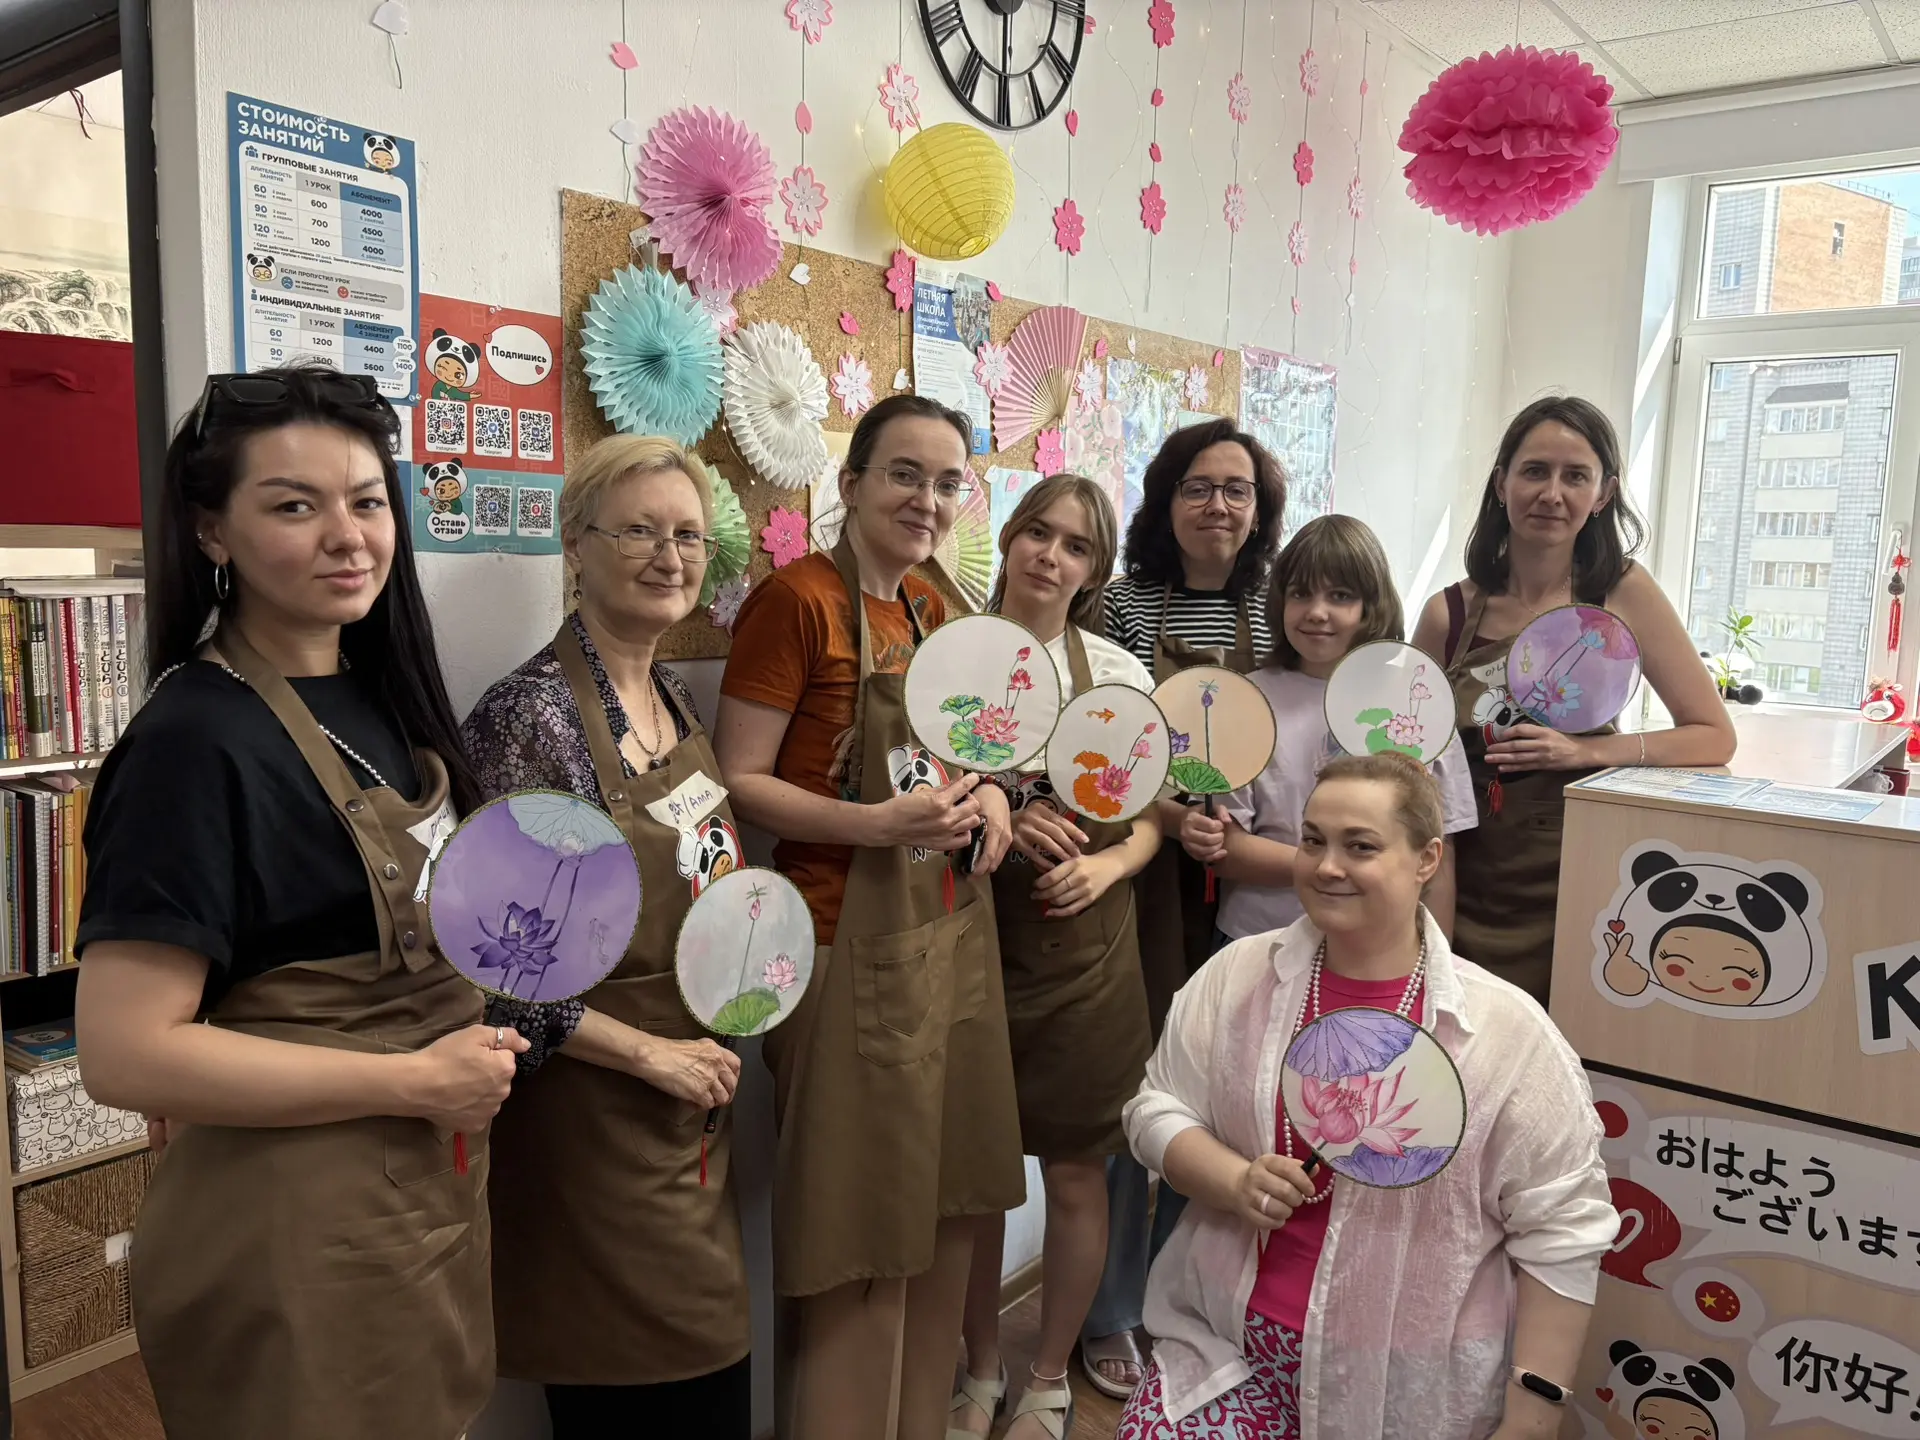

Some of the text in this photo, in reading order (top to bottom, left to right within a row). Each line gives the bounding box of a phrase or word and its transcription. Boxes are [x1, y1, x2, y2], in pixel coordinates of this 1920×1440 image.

[237, 102, 350, 143] СТОИМОСТЬ
[238, 120, 325, 153] ЗАНЯТИЙ
[262, 153, 359, 182] ГРУППОВЫЕ ЗАНЯТИЯ
[253, 184, 267, 193] 60
[310, 181, 332, 191] УРОК
[254, 204, 268, 213] 90
[311, 200, 328, 209] 600
[361, 209, 382, 219] 4000
[253, 223, 270, 233] 120
[311, 218, 329, 228] 700
[362, 227, 383, 237] 4500
[311, 237, 331, 247] 1200
[363, 245, 384, 255] 4000
[298, 271, 334, 282] ПРОПУСТИЛ
[917, 287, 946, 303] ЛЕТНЯЯ
[259, 294, 342, 315] ИНДИВИДУАЛЬНЫЕ
[917, 302, 946, 317] ШКОЛА
[314, 320, 335, 328] УРОК
[354, 323, 394, 334] АБОНЕМЕНТ
[269, 329, 282, 337] 60
[312, 337, 332, 346] 1200
[270, 348, 283, 356] 90
[364, 345, 384, 354] 4400
[491, 345, 547, 363] Подпишись
[364, 363, 384, 371] 5600
[396, 362, 413, 370] 1400
[432, 517, 466, 527] Оставь
[434, 527, 462, 535] отзыв
[101, 650, 112, 686] とびら
[116, 649, 128, 684] とびら
[1867, 955, 1920, 1040] K
[1656, 1129, 1836, 1197] おはよう
